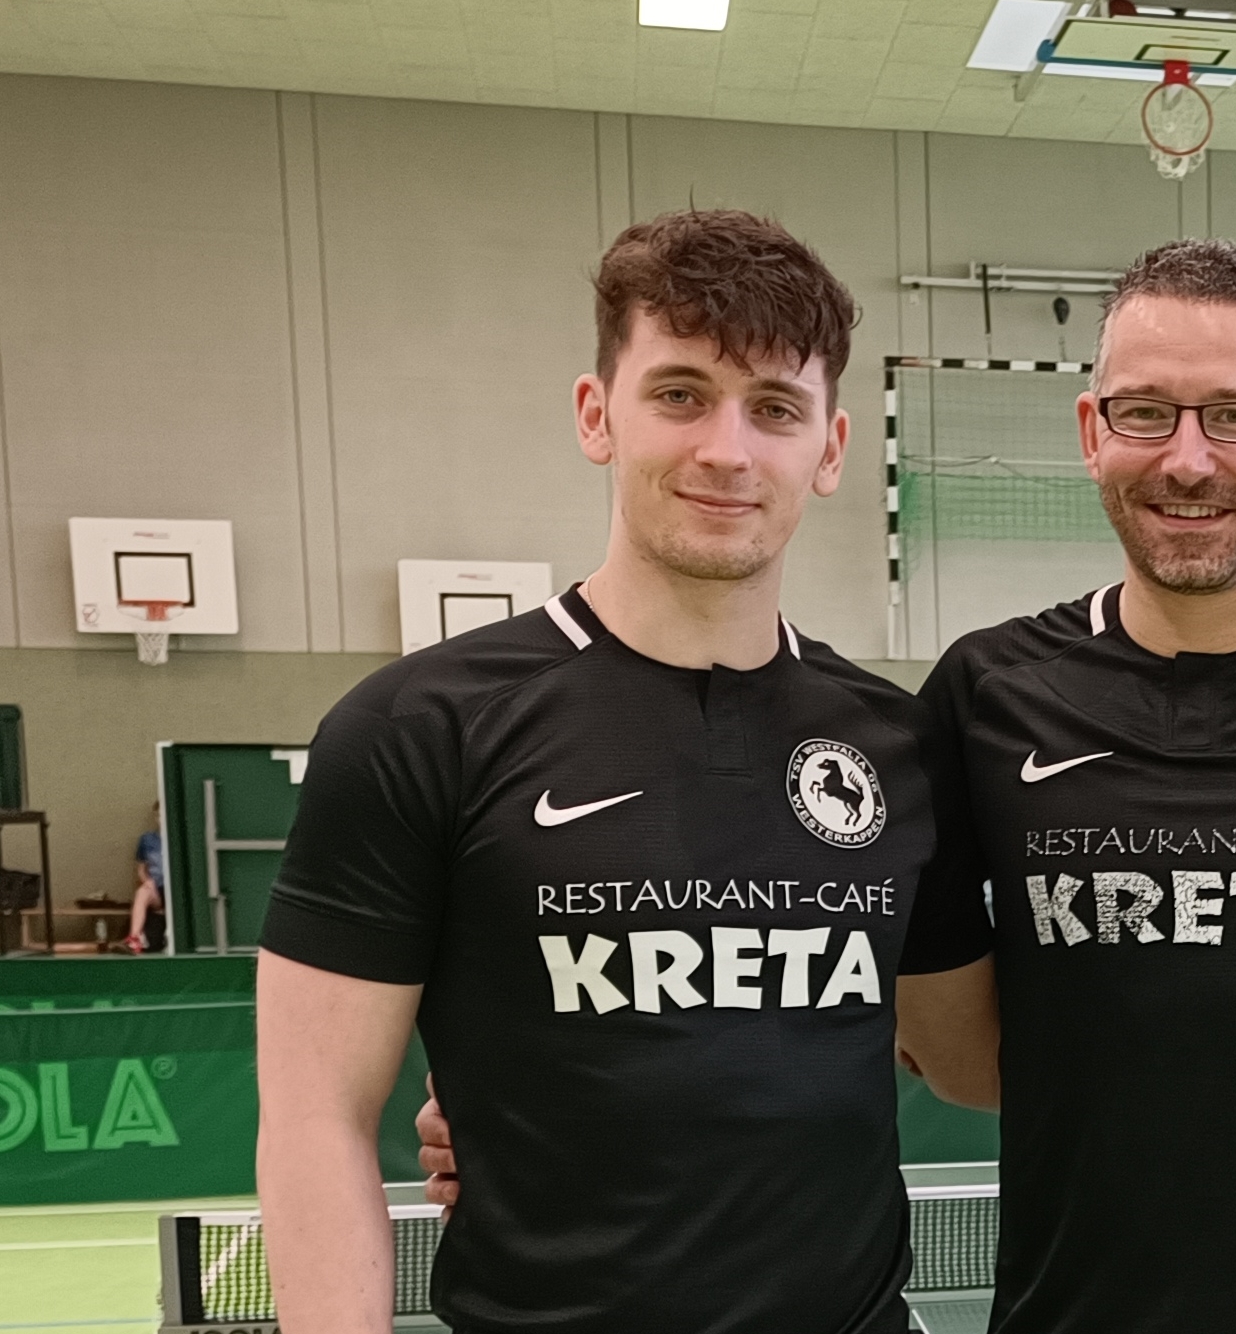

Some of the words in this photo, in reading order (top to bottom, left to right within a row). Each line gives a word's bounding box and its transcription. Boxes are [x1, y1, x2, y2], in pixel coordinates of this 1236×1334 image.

[790, 754, 804, 782] TSV
[792, 793, 885, 843] WESTERKAPPELN
[538, 879, 895, 916] RESTAURANT-CAFÉ
[538, 926, 881, 1015] KRETA
